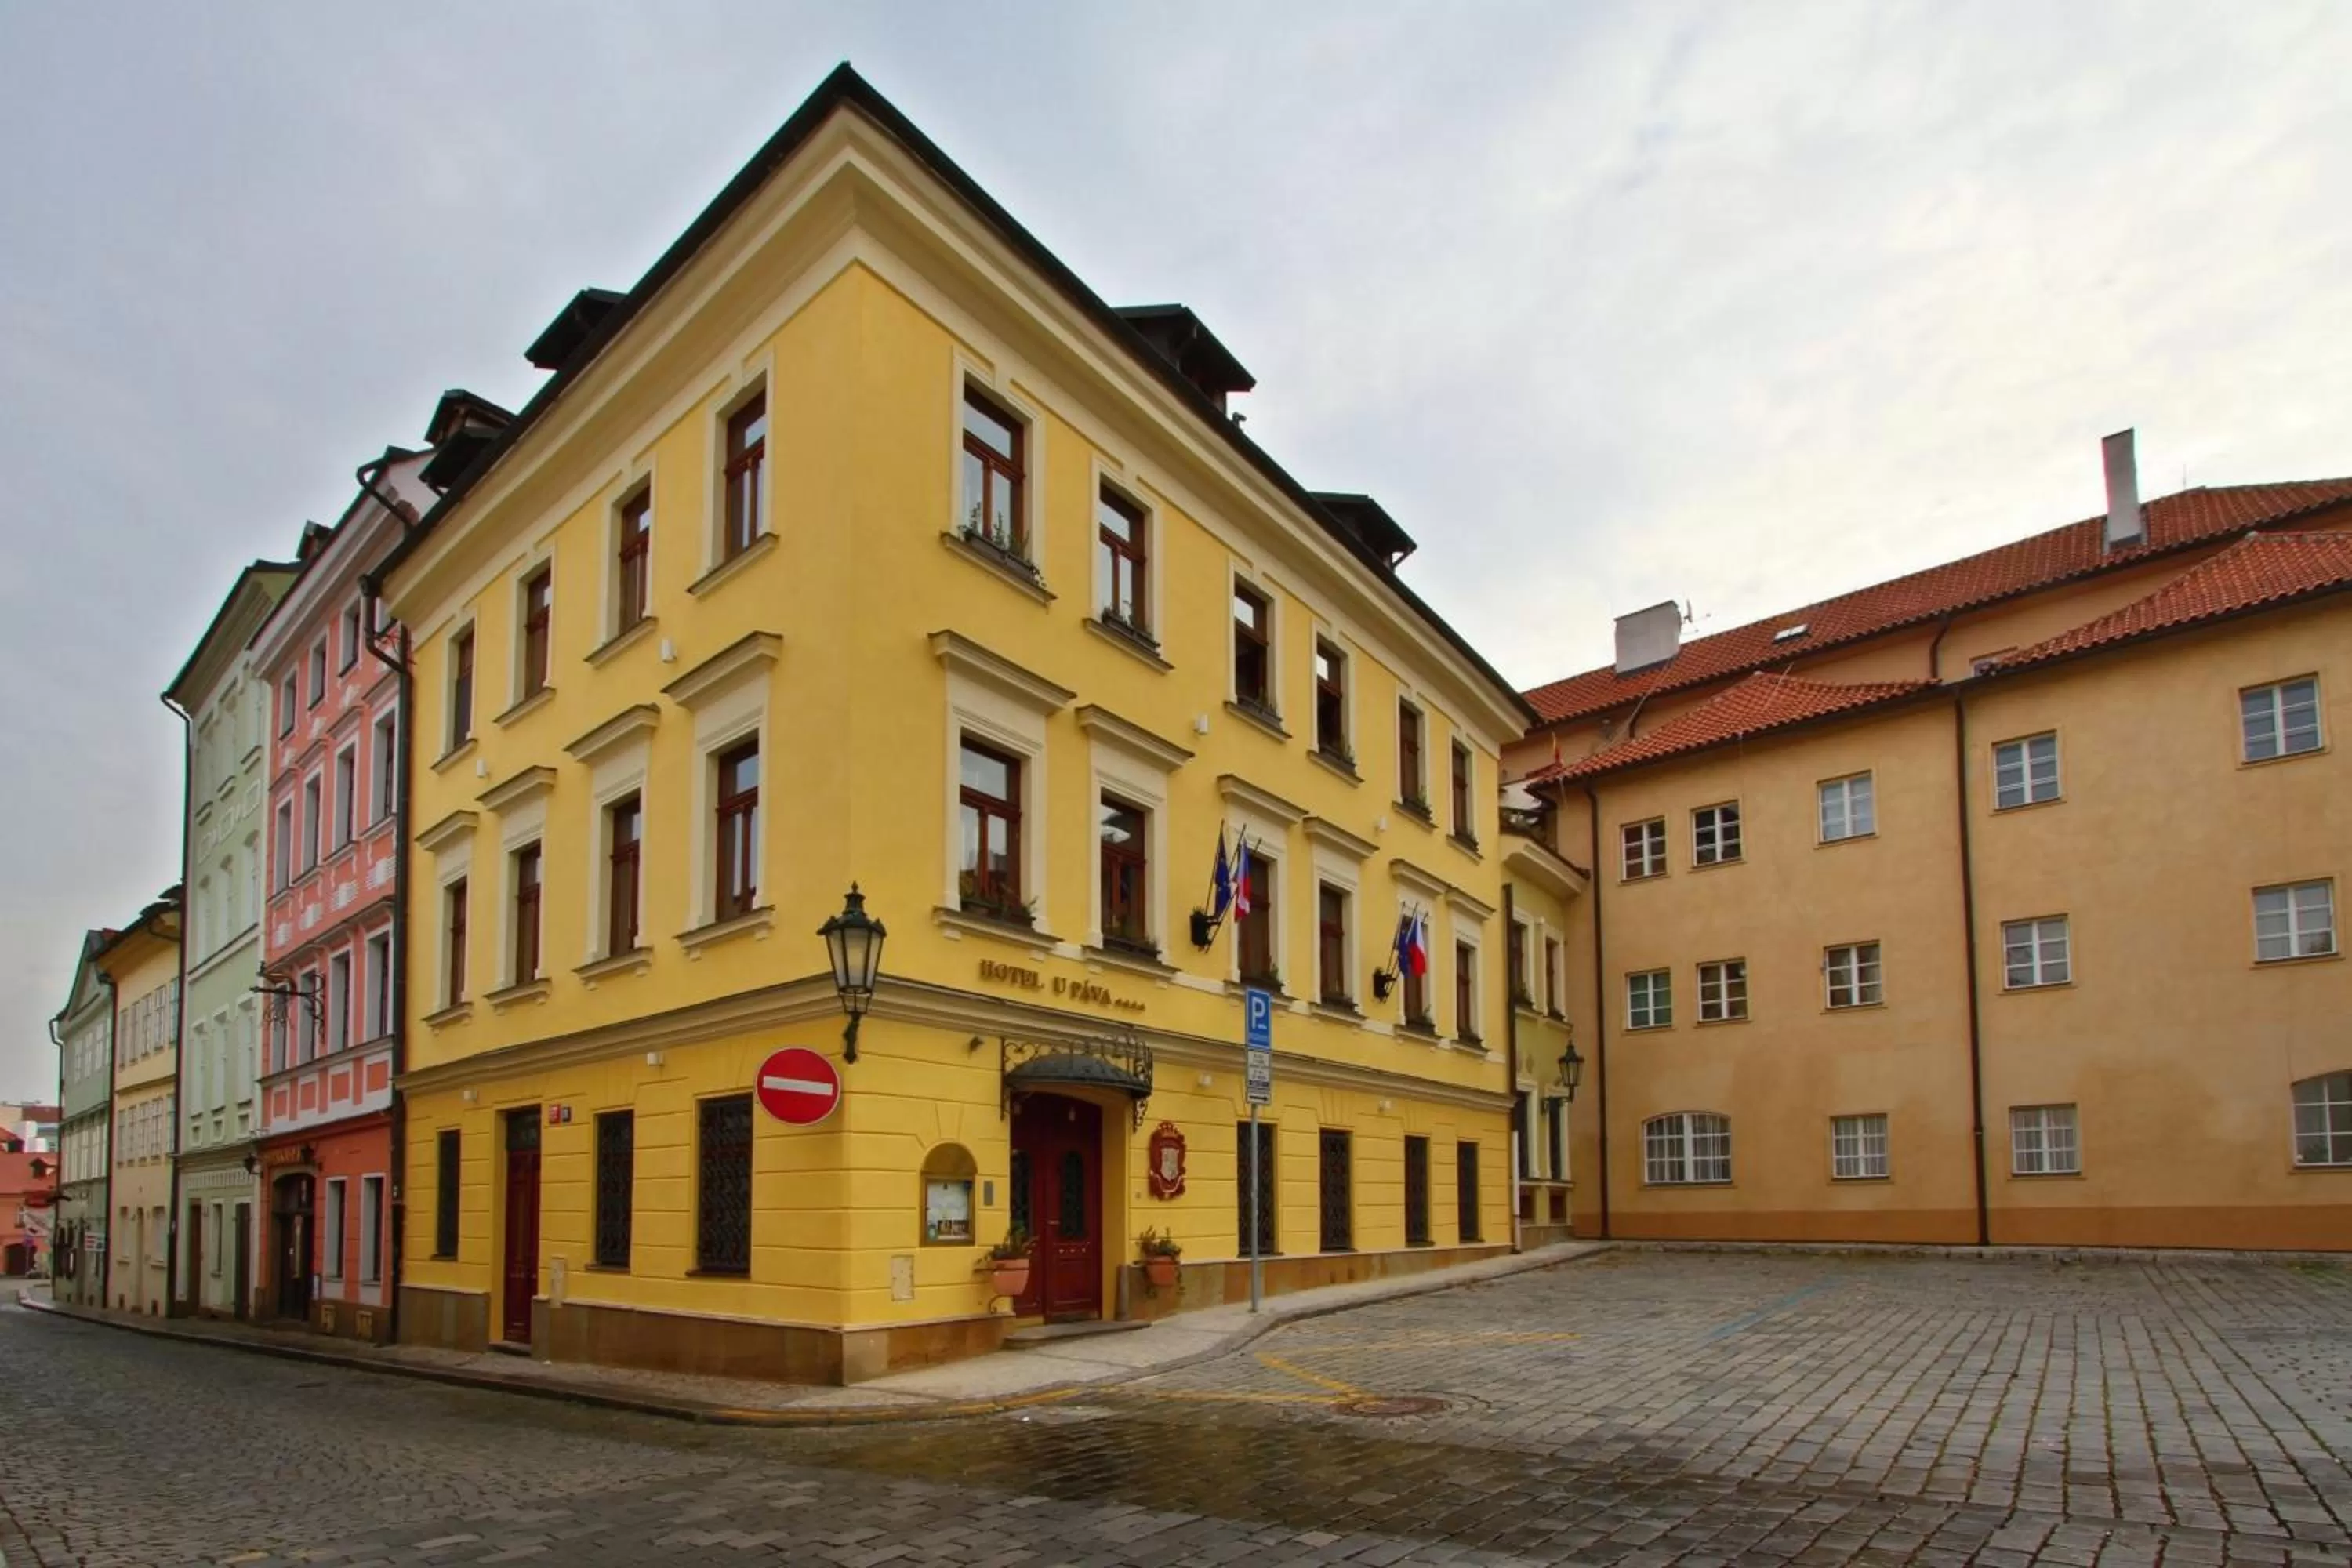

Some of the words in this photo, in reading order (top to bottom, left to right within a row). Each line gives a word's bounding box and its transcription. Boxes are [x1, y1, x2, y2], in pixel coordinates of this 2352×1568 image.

[980, 959, 1044, 989] HOTEL
[1053, 976, 1067, 995] U
[1251, 996, 1265, 1029] P
